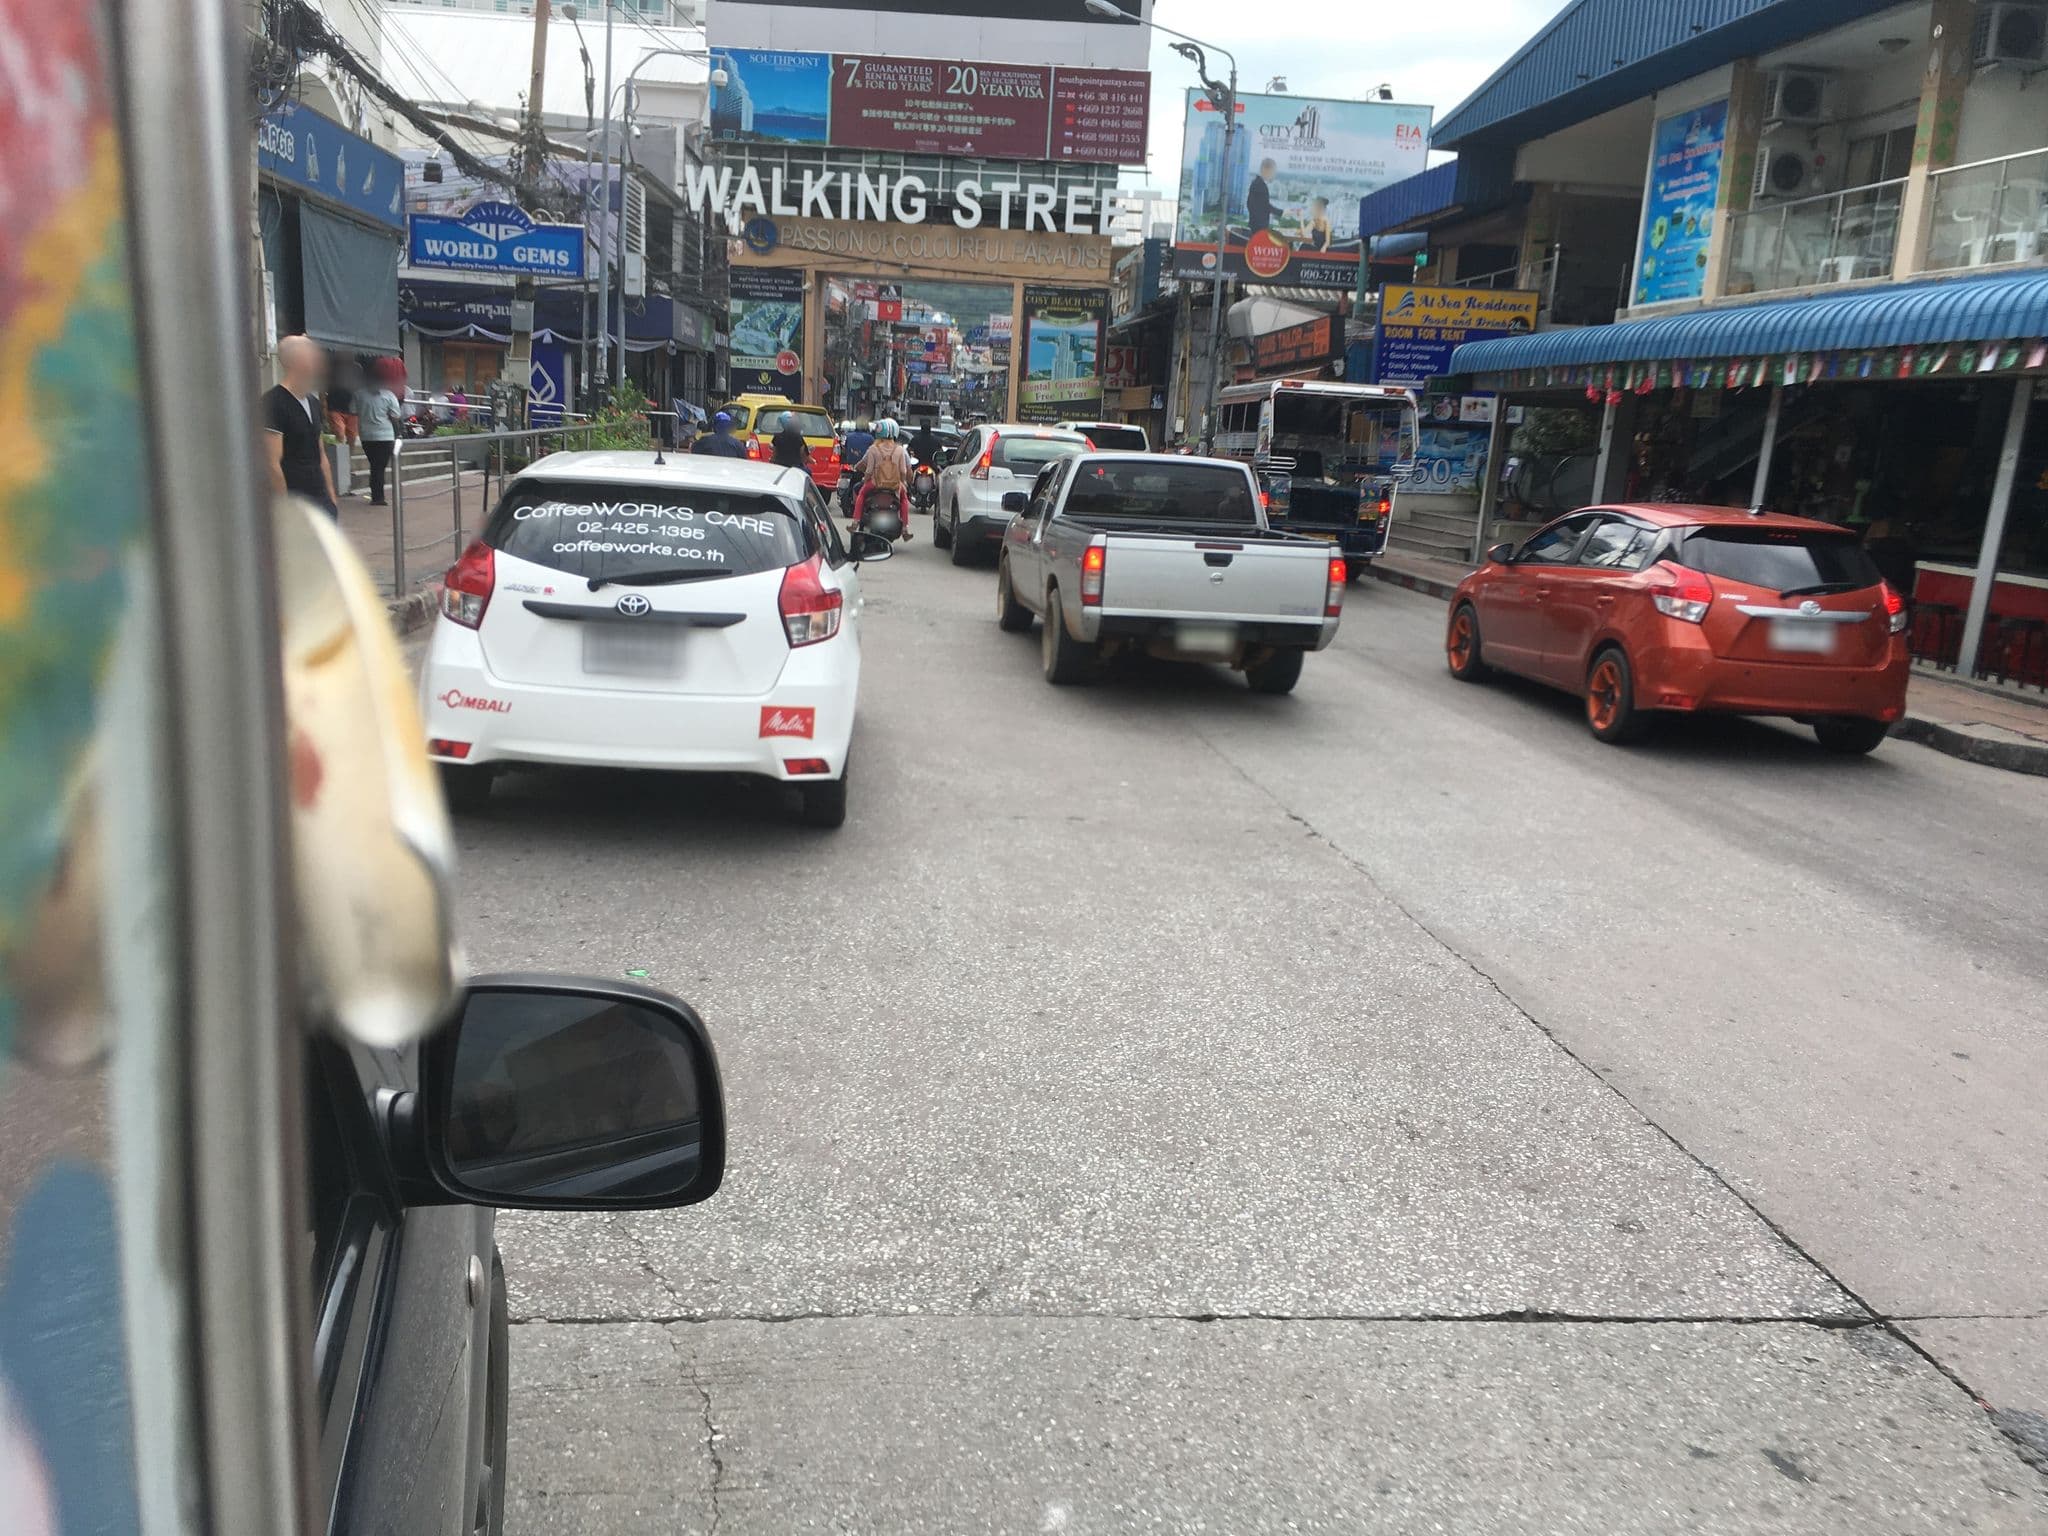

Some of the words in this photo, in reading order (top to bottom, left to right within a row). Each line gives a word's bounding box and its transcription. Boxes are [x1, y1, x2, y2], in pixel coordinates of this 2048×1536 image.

[749, 53, 821, 67] SOUTHPOINT
[864, 63, 933, 75] GUARANTEED
[865, 73, 898, 81] RENTAL
[899, 75, 932, 83] RETURN
[945, 65, 978, 95] 20
[979, 77, 990, 85] TO
[992, 78, 1018, 86] SECURE
[865, 80, 886, 89] FOR
[887, 81, 898, 90] 10
[980, 83, 1013, 97] YEAR
[1015, 85, 1045, 99] VISA
[1111, 93, 1127, 102] 416
[1259, 123, 1295, 138] CITY
[1396, 124, 1422, 139] EIA
[1293, 137, 1326, 149] TOWER
[685, 163, 927, 225] WALKING
[952, 179, 1162, 239] STREET
[424, 238, 498, 261] WORLD
[512, 246, 570, 267] GEMS
[780, 224, 864, 254] PASSION
[867, 230, 890, 253] OF
[892, 232, 1011, 263] COLOURFUL
[1014, 240, 1110, 270] PARADISE
[1252, 246, 1284, 257] WOW!
[1051, 296, 1081, 306] BEACH
[1083, 297, 1105, 308] VIEW
[1418, 295, 1436, 308] At
[1437, 295, 1461, 309] Sea
[1463, 295, 1532, 312] Residence
[1451, 316, 1472, 327] and
[1384, 326, 1414, 340] ROOM
[1417, 328, 1437, 340] FOR
[1440, 329, 1467, 341] RENT
[1411, 353, 1432, 361] View
[1387, 371, 1419, 381] Monthly
[1022, 381, 1051, 392] Rental
[1035, 392, 1055, 401] Free
[1067, 389, 1088, 399] Year
[513, 501, 694, 521] CoffeeWORKS
[704, 510, 776, 537] CARE
[576, 521, 705, 540] 02-425-1395
[552, 539, 725, 563] coffeeworks.co.th
